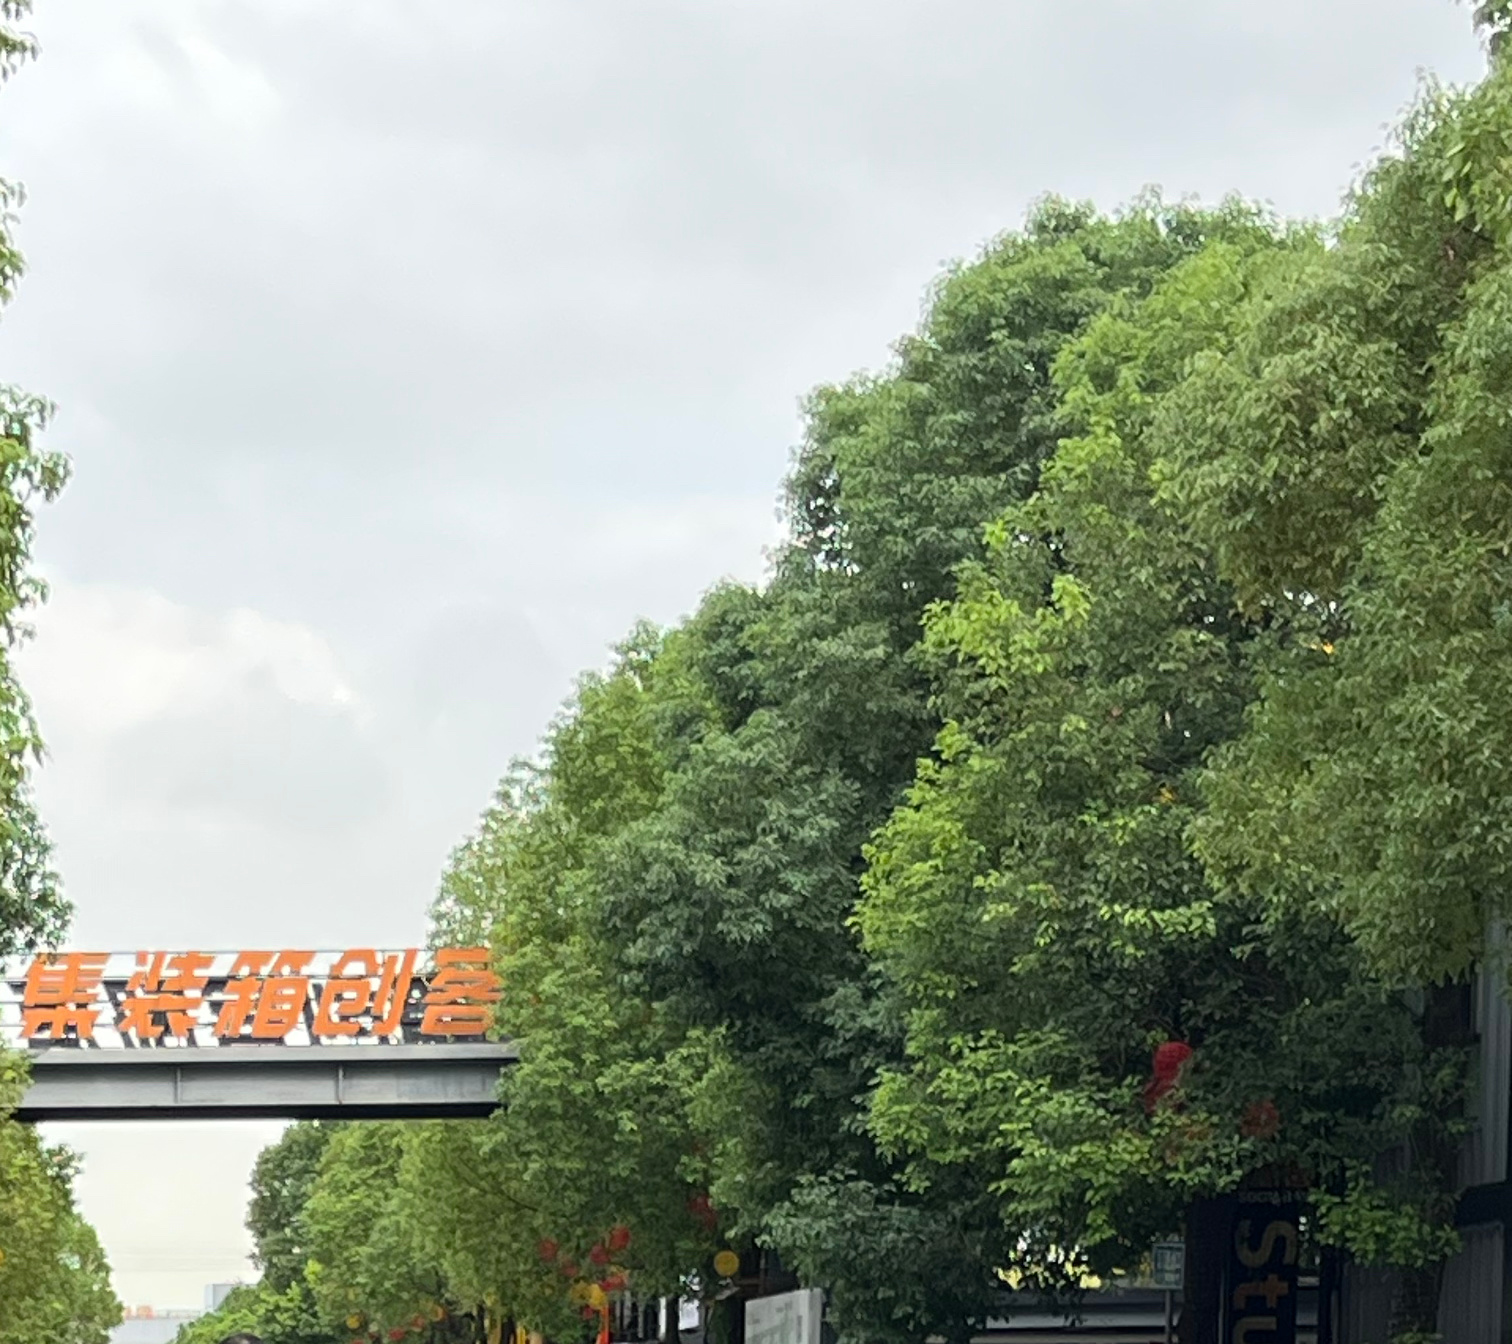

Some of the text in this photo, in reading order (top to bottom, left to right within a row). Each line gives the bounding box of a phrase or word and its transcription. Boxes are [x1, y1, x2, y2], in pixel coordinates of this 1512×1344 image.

[21, 948, 502, 1038] 集装箱创客
